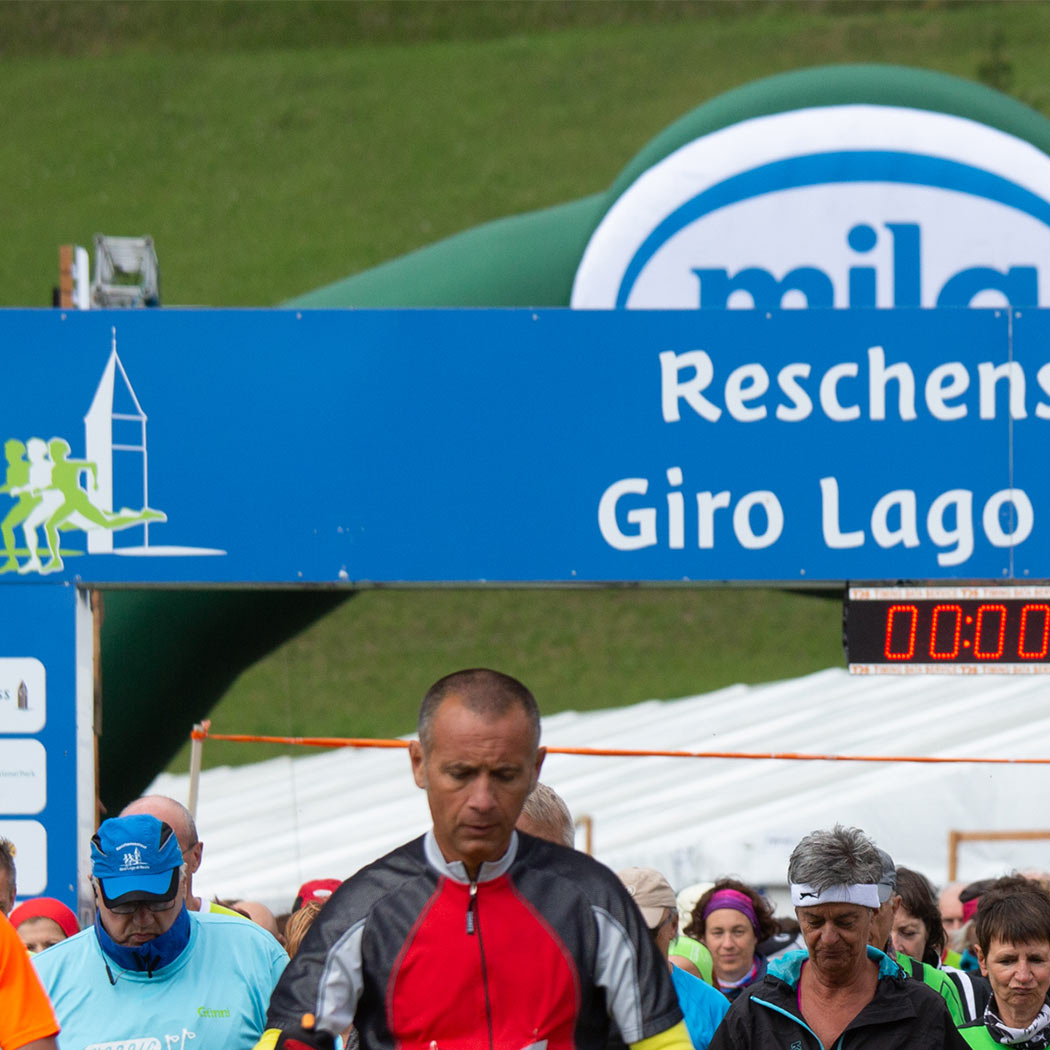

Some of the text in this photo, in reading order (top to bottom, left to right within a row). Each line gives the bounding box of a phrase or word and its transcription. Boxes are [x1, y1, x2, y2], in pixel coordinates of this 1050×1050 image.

[691, 223, 1038, 308] mila
[599, 468, 785, 552] Giro
[821, 478, 1035, 568] Lago
